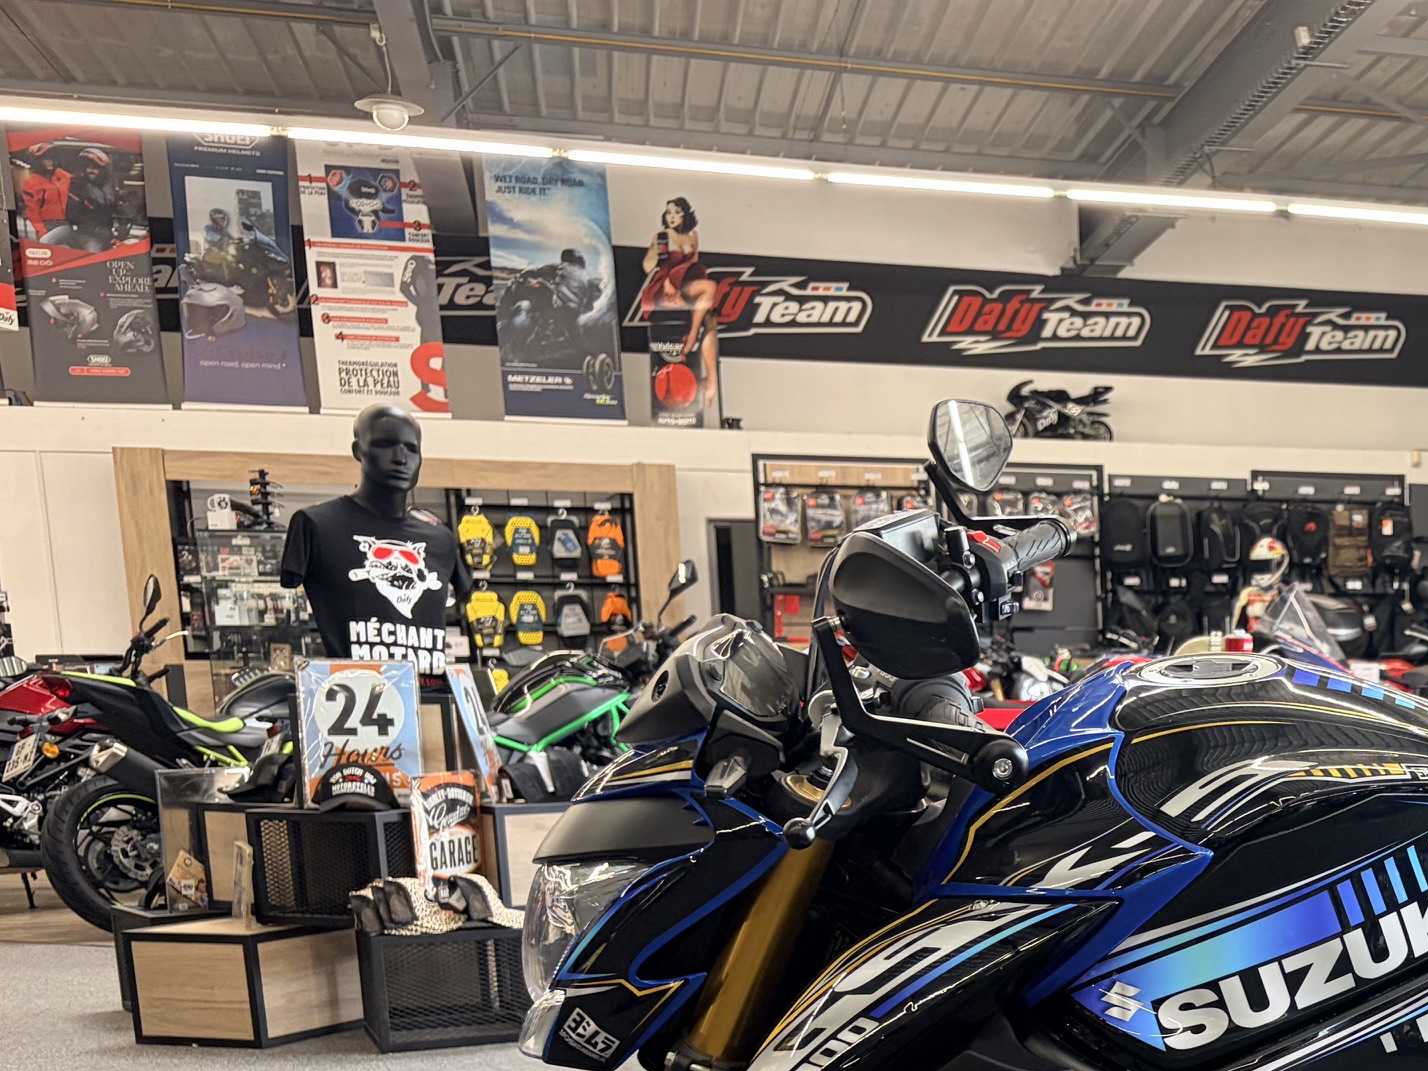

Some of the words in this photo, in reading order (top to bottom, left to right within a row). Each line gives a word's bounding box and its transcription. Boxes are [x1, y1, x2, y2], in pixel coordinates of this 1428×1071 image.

[437, 276, 497, 305] Te
[752, 296, 864, 324] Team
[946, 293, 1045, 340] Dafy
[1040, 311, 1141, 339] Team
[1217, 310, 1313, 351] Dafy
[1304, 325, 1400, 351] Team
[338, 367, 399, 378] PROTECTION
[339, 377, 353, 388] DE
[356, 377, 370, 388] LA
[372, 378, 400, 389] PEAU
[507, 374, 563, 384] METZELER
[349, 617, 445, 650] MÉCHANT
[351, 644, 446, 675] MOTARD
[325, 683, 395, 737] 24
[320, 739, 404, 768] Hours
[429, 836, 479, 871] GARAGE
